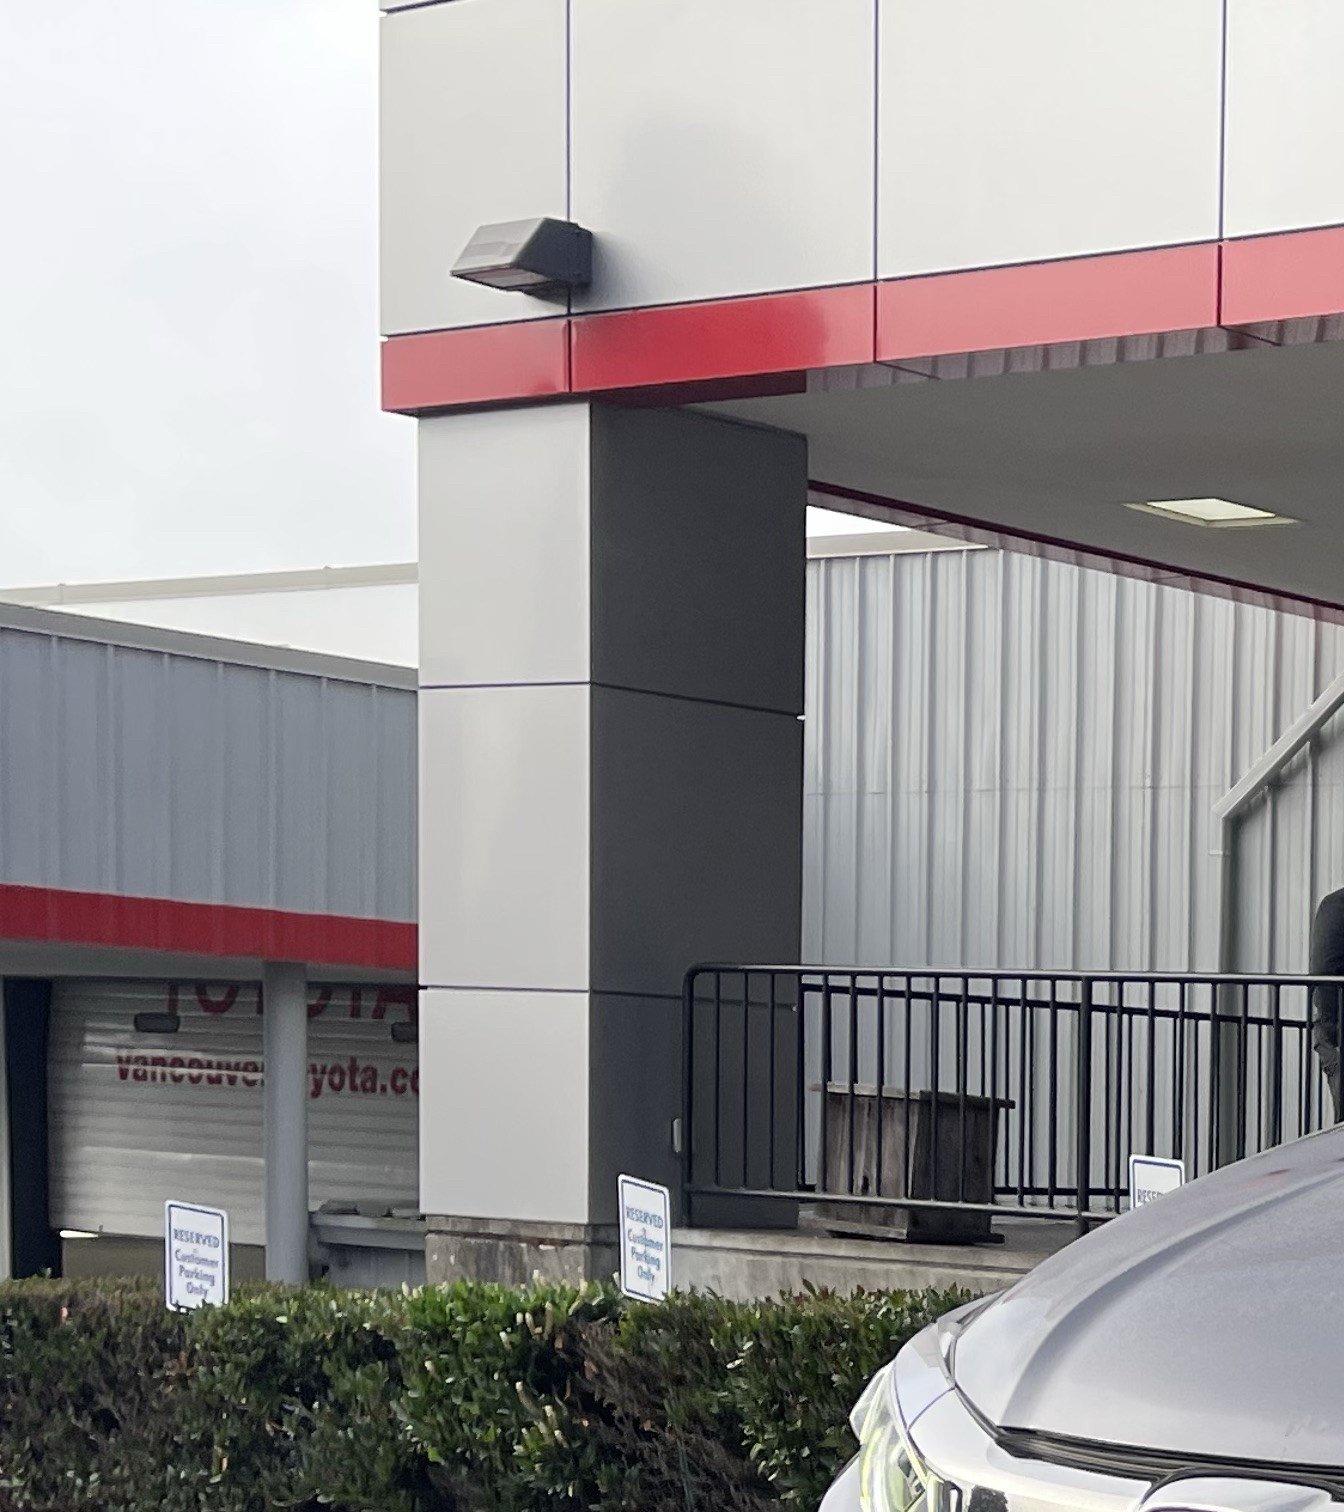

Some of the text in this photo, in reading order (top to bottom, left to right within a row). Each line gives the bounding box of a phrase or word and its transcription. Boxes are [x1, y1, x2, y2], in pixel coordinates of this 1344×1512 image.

[626, 1206, 664, 1230] RESERVED
[173, 1228, 220, 1249] RESERVED
[627, 1228, 663, 1252] Customer
[174, 1248, 220, 1268] Customer
[630, 1246, 661, 1271] Parking
[178, 1264, 215, 1287] Parking
[637, 1265, 655, 1287] Only
[186, 1281, 208, 1299] Only
